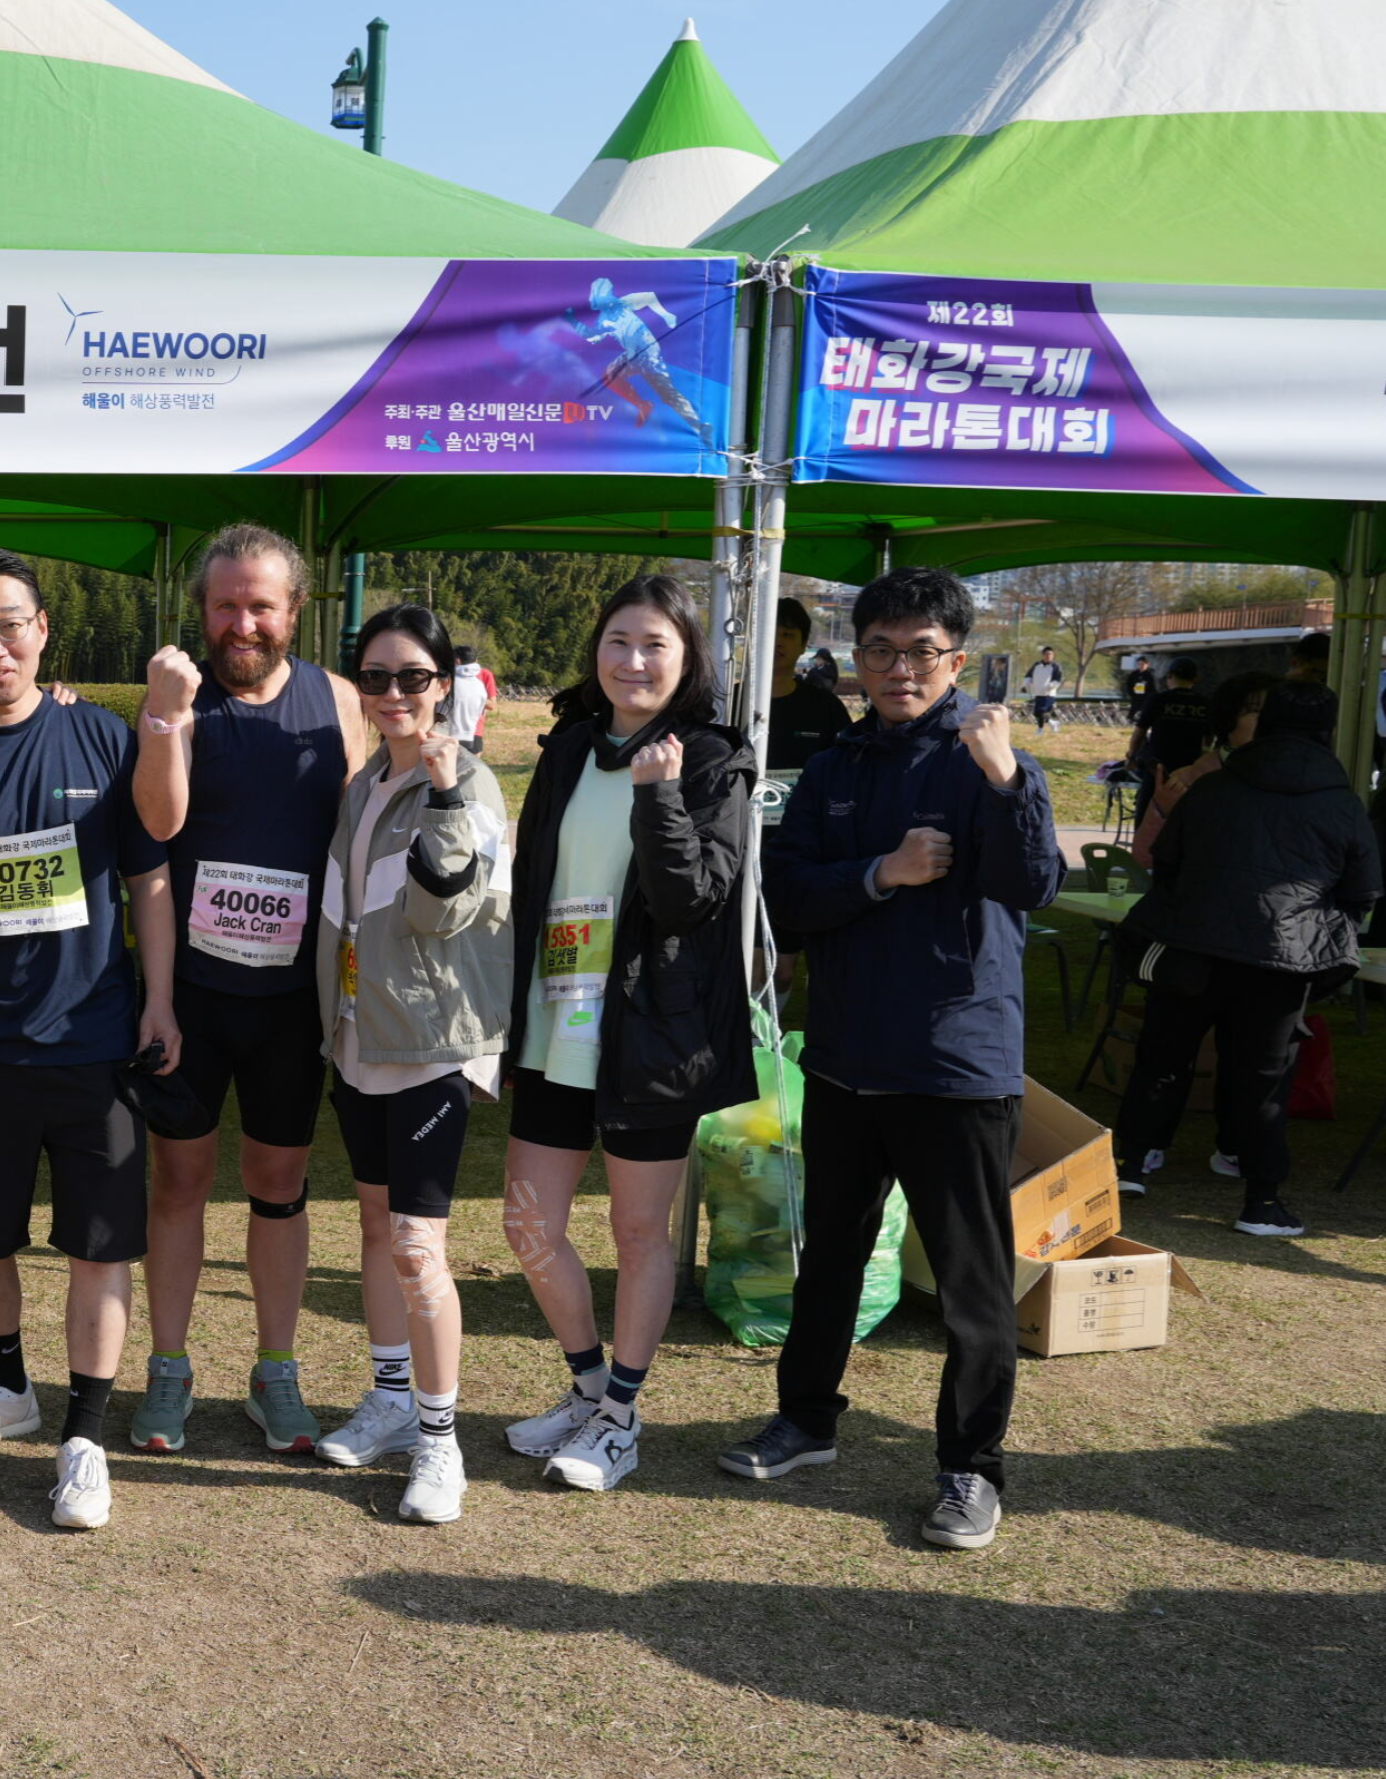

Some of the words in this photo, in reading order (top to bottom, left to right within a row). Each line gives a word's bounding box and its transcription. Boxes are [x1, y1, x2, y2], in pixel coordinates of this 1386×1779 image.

[927, 300, 1015, 327] 제22회
[83, 331, 267, 360] HAEWOORI
[82, 366, 166, 378] OFFSHORE
[176, 368, 216, 378] WIND
[819, 336, 1092, 398] 태화강국제
[82, 392, 125, 410] 해울이
[130, 393, 214, 410] 해상풍력발전
[446, 402, 562, 423] 울산매일신문
[842, 399, 1111, 455] 마라톤대회
[385, 435, 411, 450] 후원
[445, 432, 535, 453] 울산광역시
[23, 832, 72, 850] 국제마라톤대회
[202, 867, 228, 879] 제22회
[229, 870, 253, 883] 태화강
[255, 873, 304, 889] 국제마라톤대회
[210, 888, 291, 919] 40066
[214, 913, 246, 930] Jack
[251, 917, 282, 934] Cran
[383, 1363, 403, 1371] NIKE
